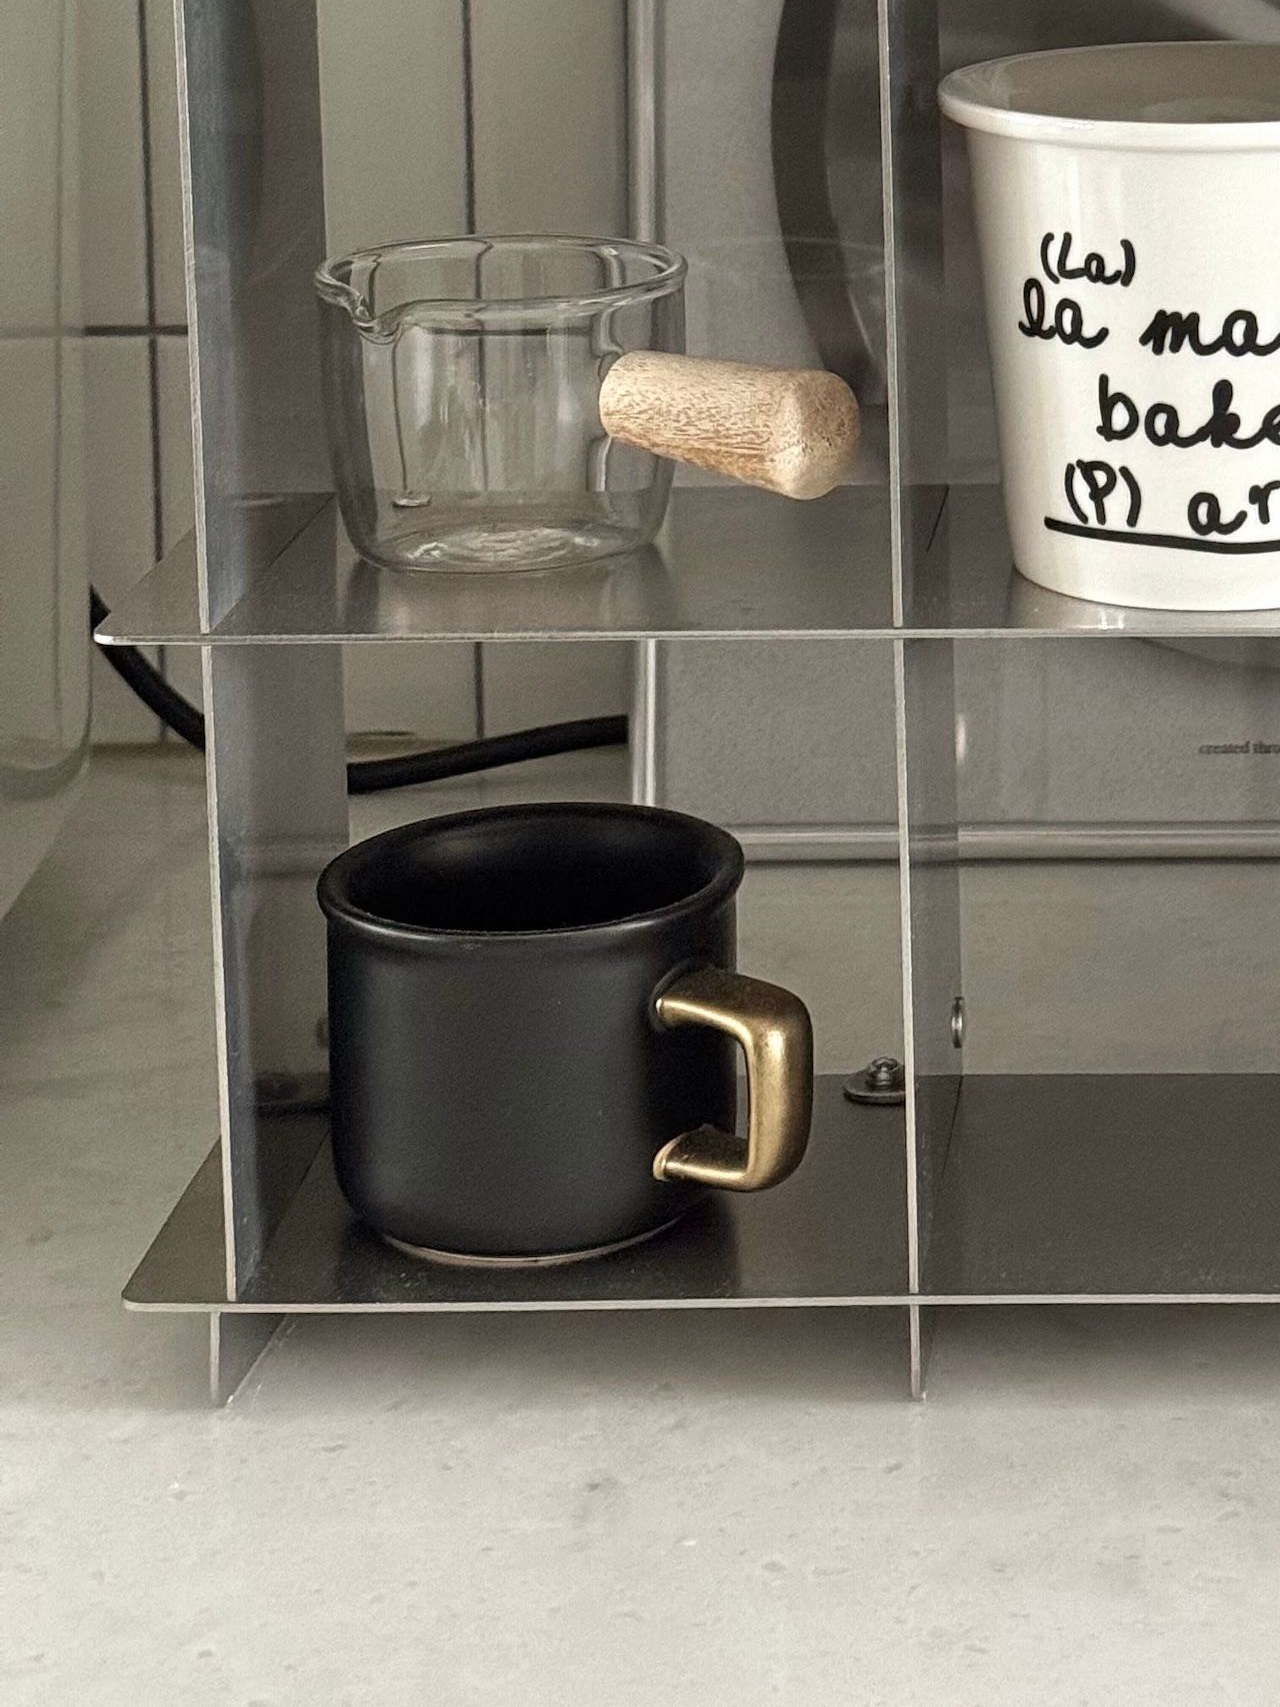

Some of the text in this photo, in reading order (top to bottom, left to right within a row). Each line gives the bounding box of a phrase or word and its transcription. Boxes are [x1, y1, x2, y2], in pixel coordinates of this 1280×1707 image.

[1040, 232, 1136, 287] (La)
[1018, 278, 1110, 349] la
[1065, 460, 1141, 527] (P)
[1199, 740, 1250, 754] created
